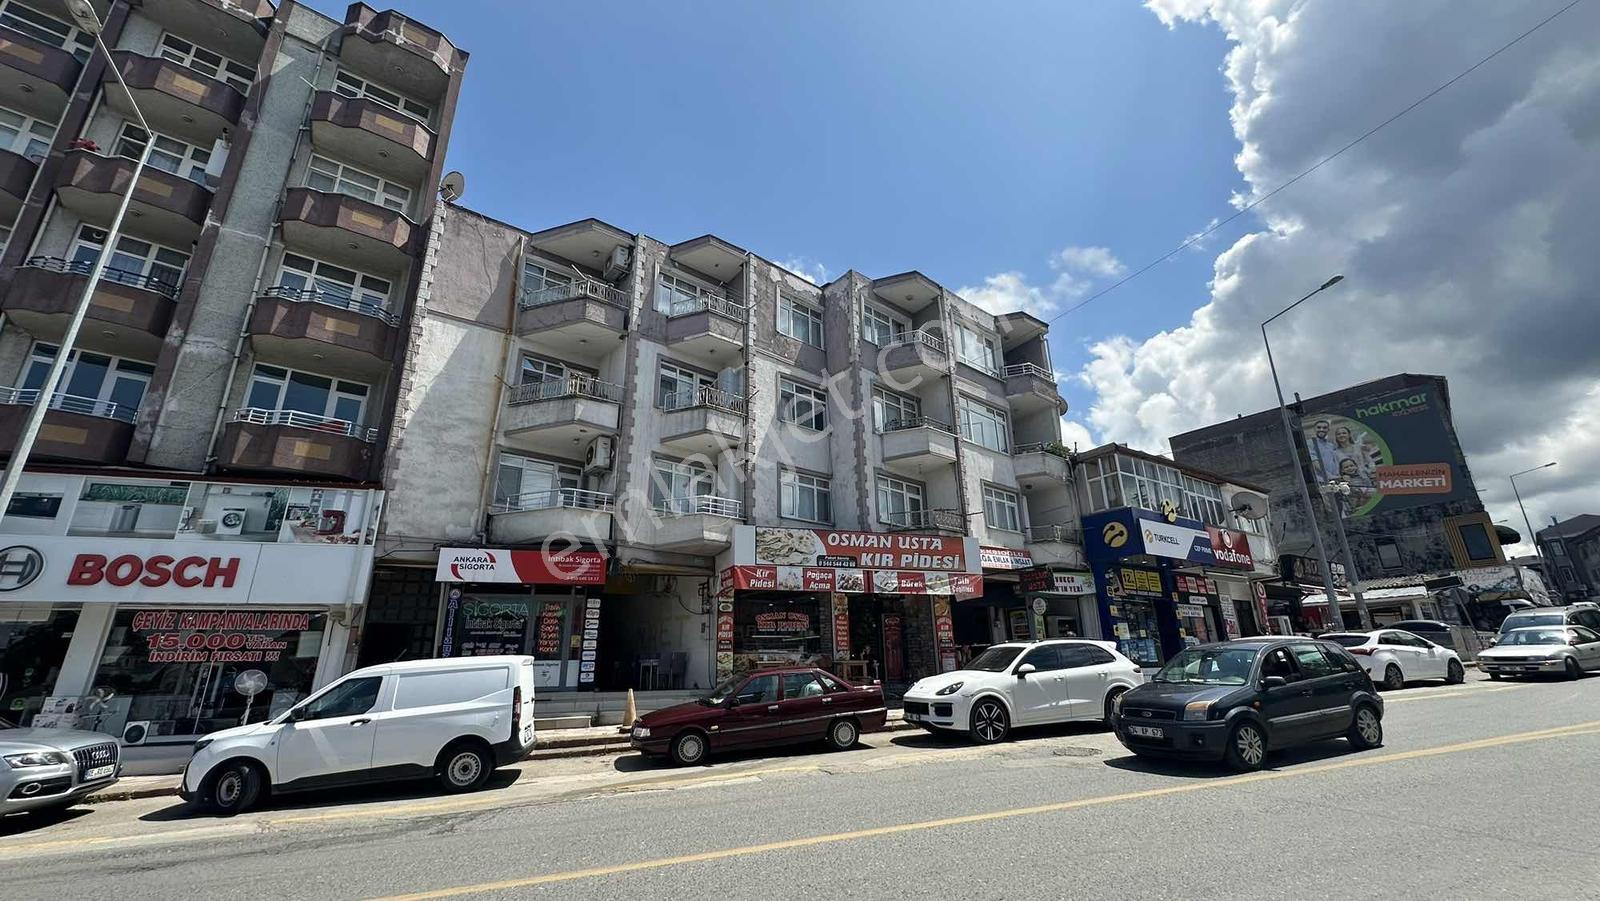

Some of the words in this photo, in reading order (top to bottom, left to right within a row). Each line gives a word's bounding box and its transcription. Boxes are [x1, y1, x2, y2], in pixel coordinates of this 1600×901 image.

[1354, 392, 1428, 418] hakmar
[1379, 475, 1446, 488] MARKETİ
[827, 532, 892, 549] OSMAN
[898, 536, 943, 550] USTA
[1153, 533, 1180, 545] TURKCELL
[575, 556, 601, 565] Sigorta
[860, 552, 895, 567] KIR
[900, 552, 960, 569] PİDESİ
[1213, 549, 1252, 564] vodafone
[67, 553, 241, 588] BOSCH
[459, 562, 495, 570] SİGORTA
[756, 568, 769, 578] Kır
[806, 570, 833, 581] Poğaça
[750, 577, 775, 588] Pidesi
[809, 580, 831, 590] Açma
[901, 579, 923, 588] Börek
[462, 601, 529, 617] SİGORTA
[132, 609, 177, 632] ÇEYİZ
[178, 611, 310, 631] KAMPANYALARINDA
[146, 632, 247, 650] 15.000
[246, 641, 288, 649] VARAN
[148, 648, 208, 662] İNDİRİM
[209, 651, 263, 662] FIRSATI
